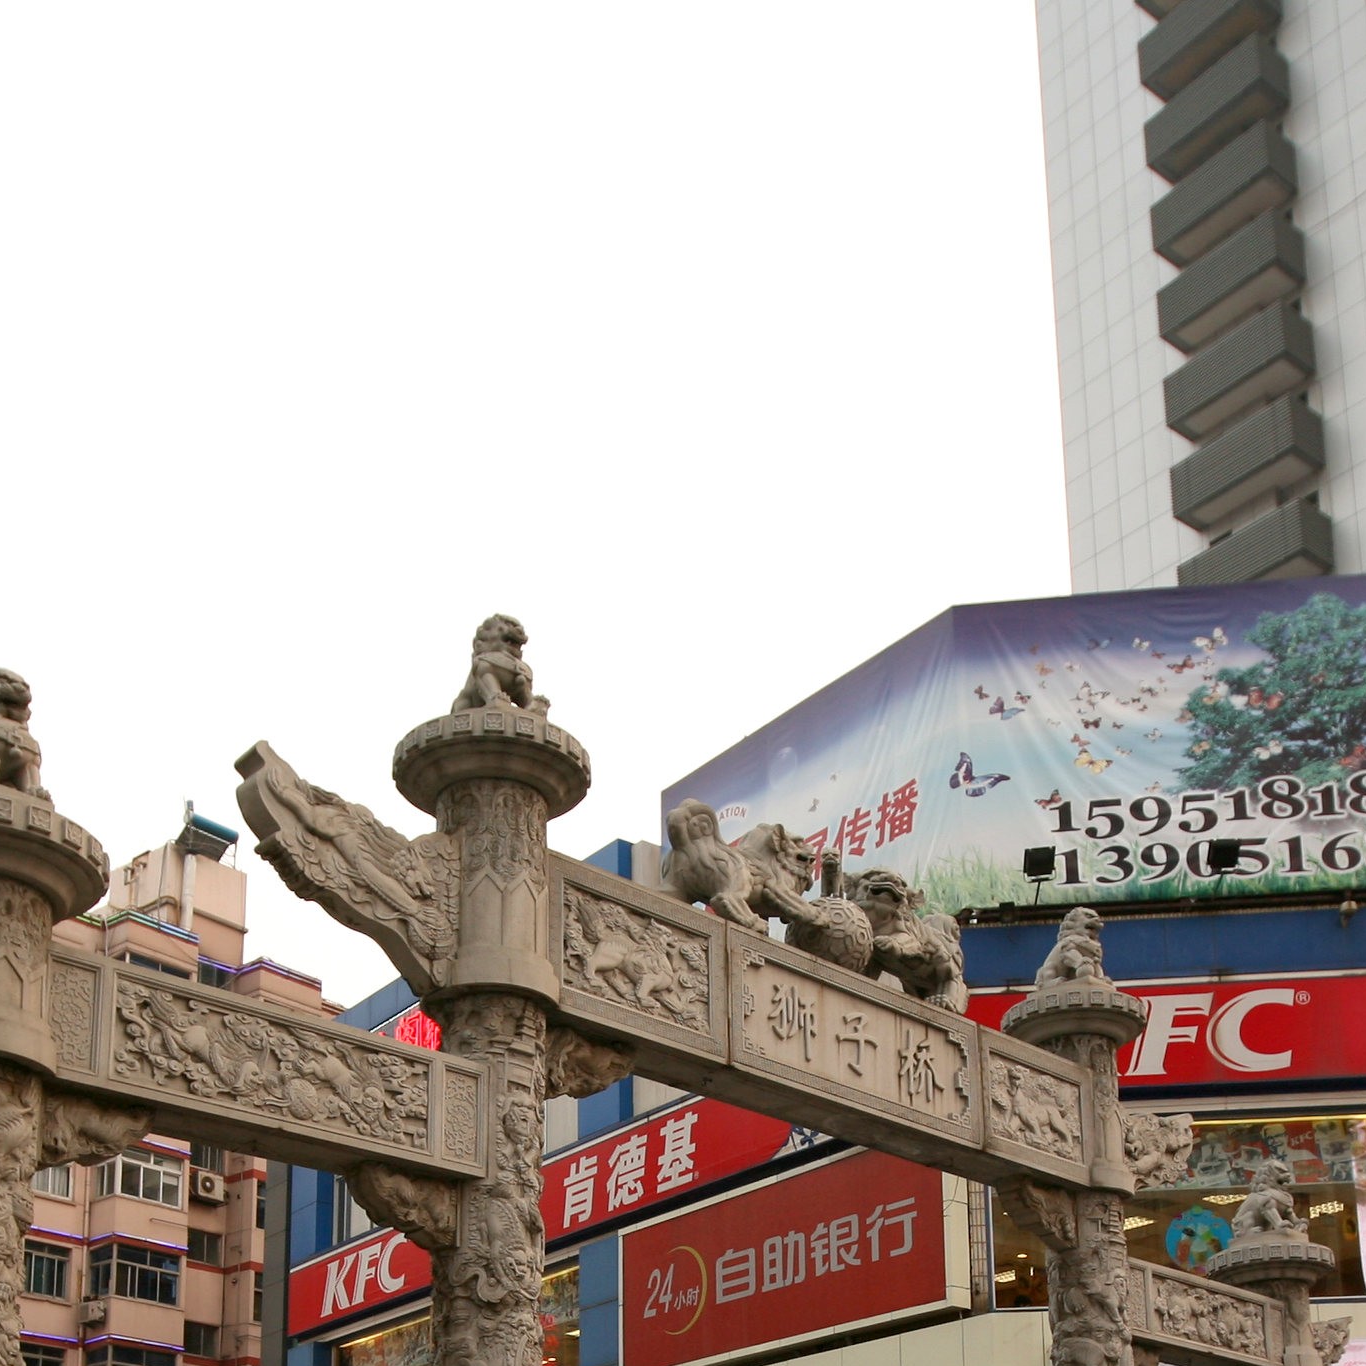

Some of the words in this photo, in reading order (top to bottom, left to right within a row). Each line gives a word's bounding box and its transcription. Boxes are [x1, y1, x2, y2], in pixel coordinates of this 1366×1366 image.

[767, 984, 945, 1103] 狮子桥
[1117, 988, 1295, 1077] FC
[561, 1112, 699, 1229] 肯德基
[320, 1232, 408, 1318] KFC
[714, 1197, 917, 1306] 自助银行
